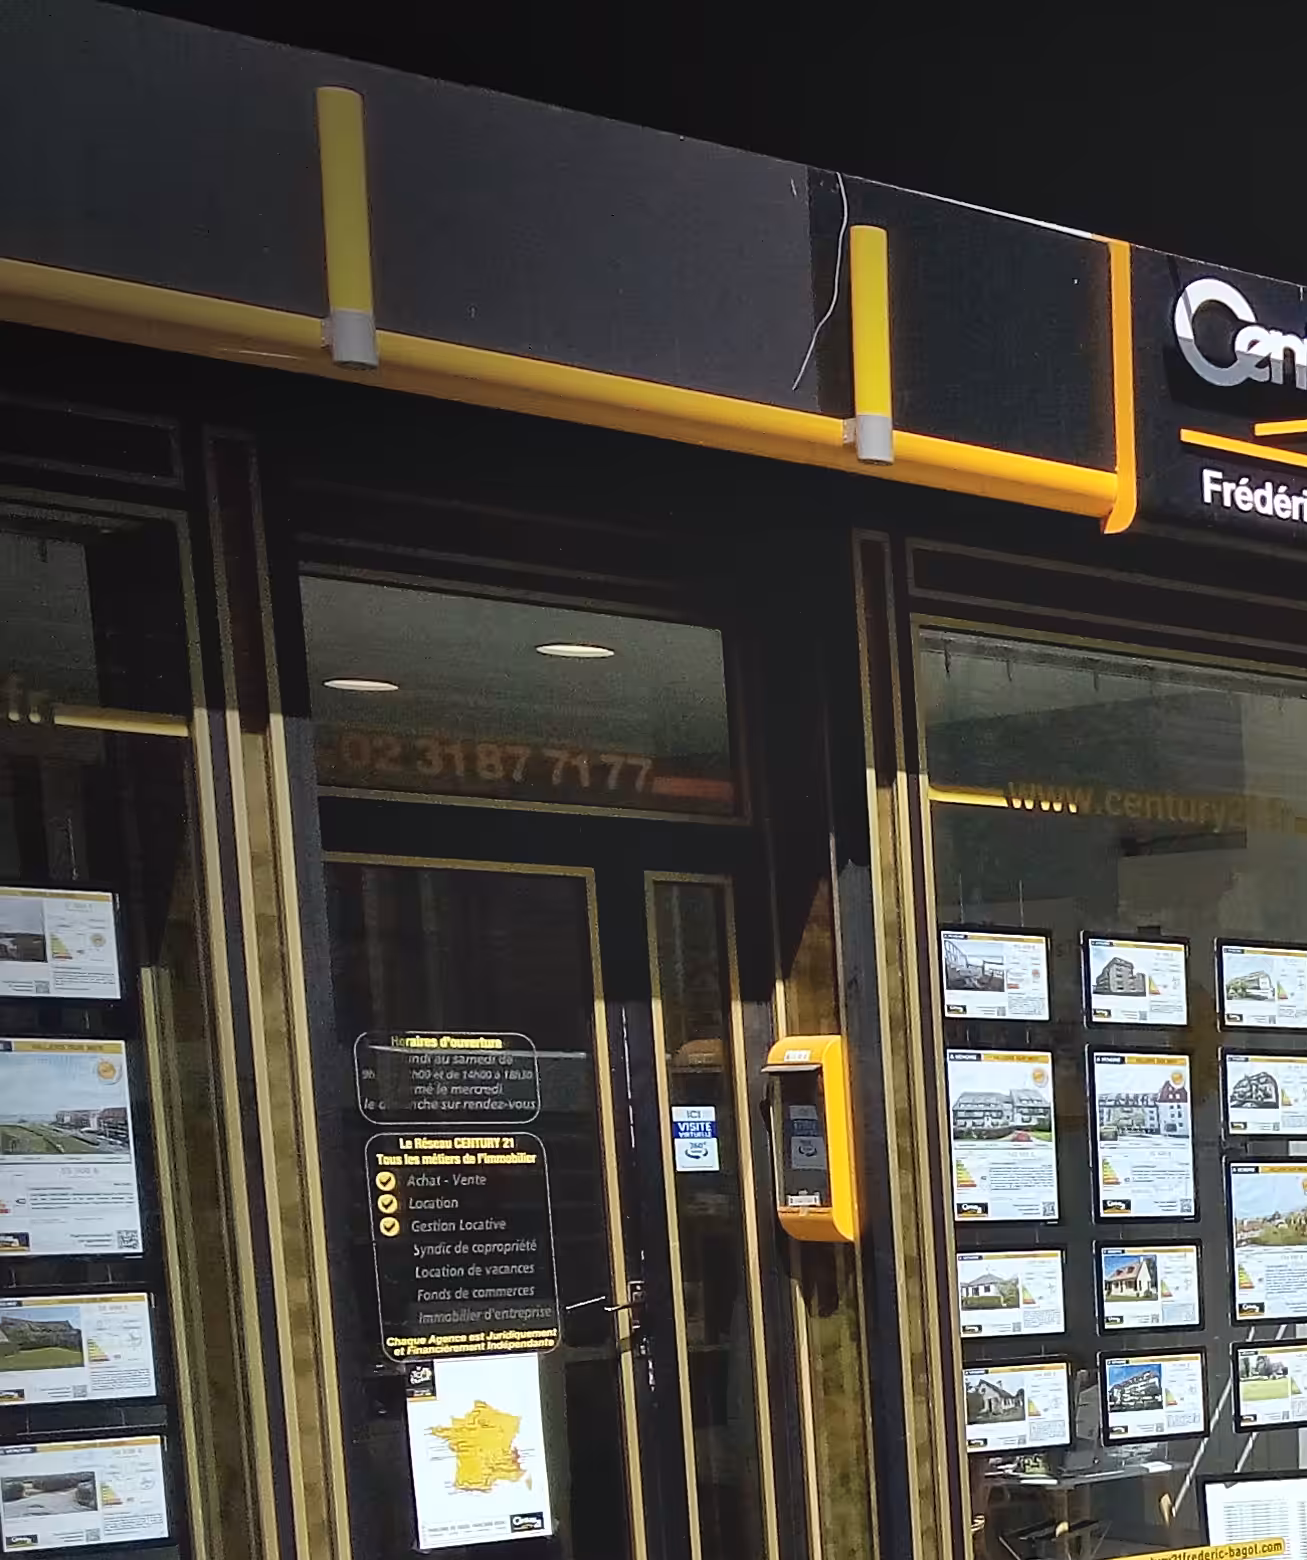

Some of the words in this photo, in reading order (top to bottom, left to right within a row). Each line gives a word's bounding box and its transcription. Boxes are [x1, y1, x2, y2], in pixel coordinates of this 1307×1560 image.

[601, 753, 654, 792] 77
[452, 1053, 497, 1065] samedi
[450, 1083, 503, 1096] mercredi
[462, 1099, 537, 1111] rendez-vous
[677, 1122, 713, 1131] VISITE
[399, 1137, 413, 1149] Le
[414, 1137, 453, 1149] Réseau
[453, 1137, 501, 1149] CENTURY
[502, 1137, 515, 1148] 21
[376, 1153, 403, 1165] Tous
[404, 1153, 420, 1165] les
[421, 1153, 461, 1165] métiers
[462, 1153, 476, 1164] de
[406, 1174, 441, 1187] Achat
[452, 1174, 487, 1186] Vente
[408, 1197, 459, 1209] Location
[411, 1219, 456, 1232] Gestion
[459, 1217, 507, 1231] Locative
[413, 1241, 451, 1258] Syndic
[454, 1240, 469, 1254] de
[471, 1238, 538, 1257] copropriété
[415, 1264, 465, 1279] Location
[467, 1263, 482, 1276] de
[485, 1263, 535, 1275] vacances
[417, 1287, 451, 1301] Fonds
[455, 1286, 470, 1299] de
[472, 1286, 535, 1299] commerces
[419, 1309, 481, 1324] Immobilier
[484, 1307, 552, 1321] d'entreprise
[386, 1336, 426, 1348] Chaque
[428, 1334, 467, 1345] Agence
[468, 1332, 485, 1341] est
[486, 1327, 558, 1341] Juridiquement
[394, 1346, 406, 1356] et
[406, 1342, 486, 1356] Financièrement
[487, 1338, 555, 1351] Indépendante
